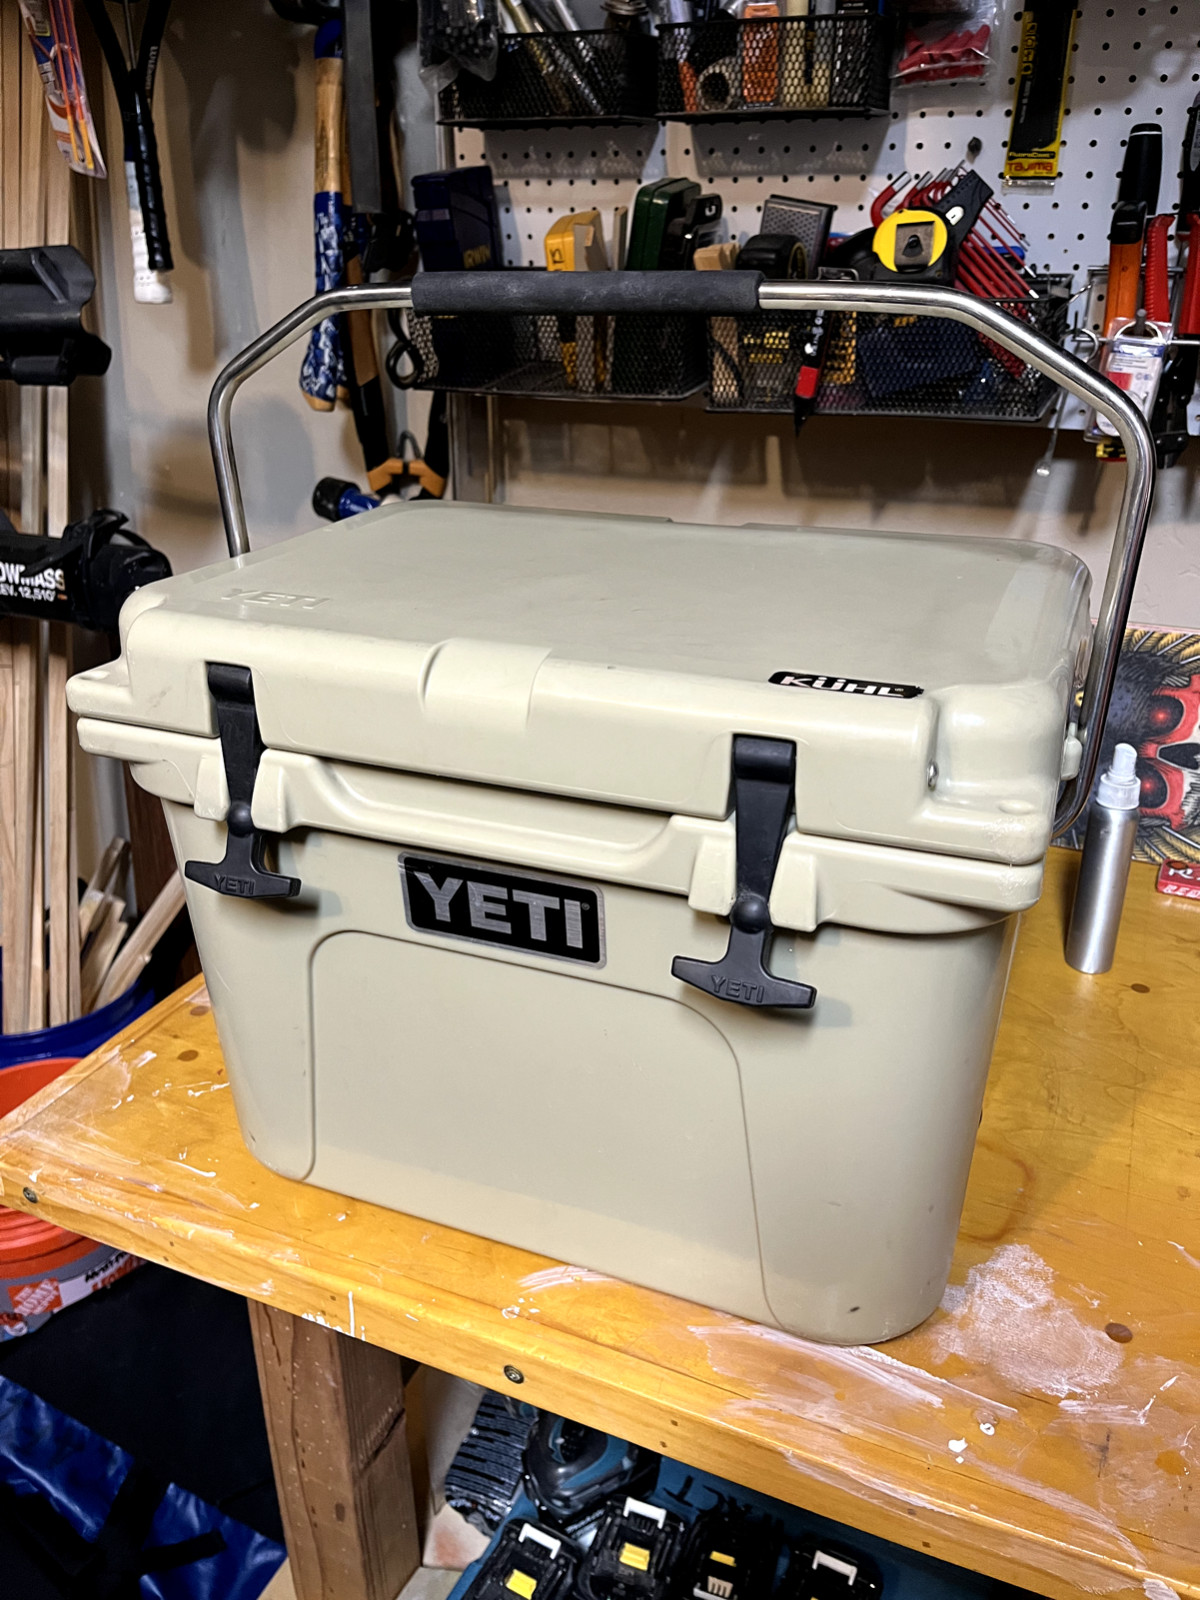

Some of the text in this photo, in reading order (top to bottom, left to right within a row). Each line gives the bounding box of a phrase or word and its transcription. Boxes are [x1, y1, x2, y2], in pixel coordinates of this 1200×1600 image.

[220, 588, 331, 610] YETI
[780, 676, 904, 698] KÜHL
[214, 873, 256, 896] YETI
[413, 871, 584, 950] YETI
[710, 974, 765, 1004] YETI
